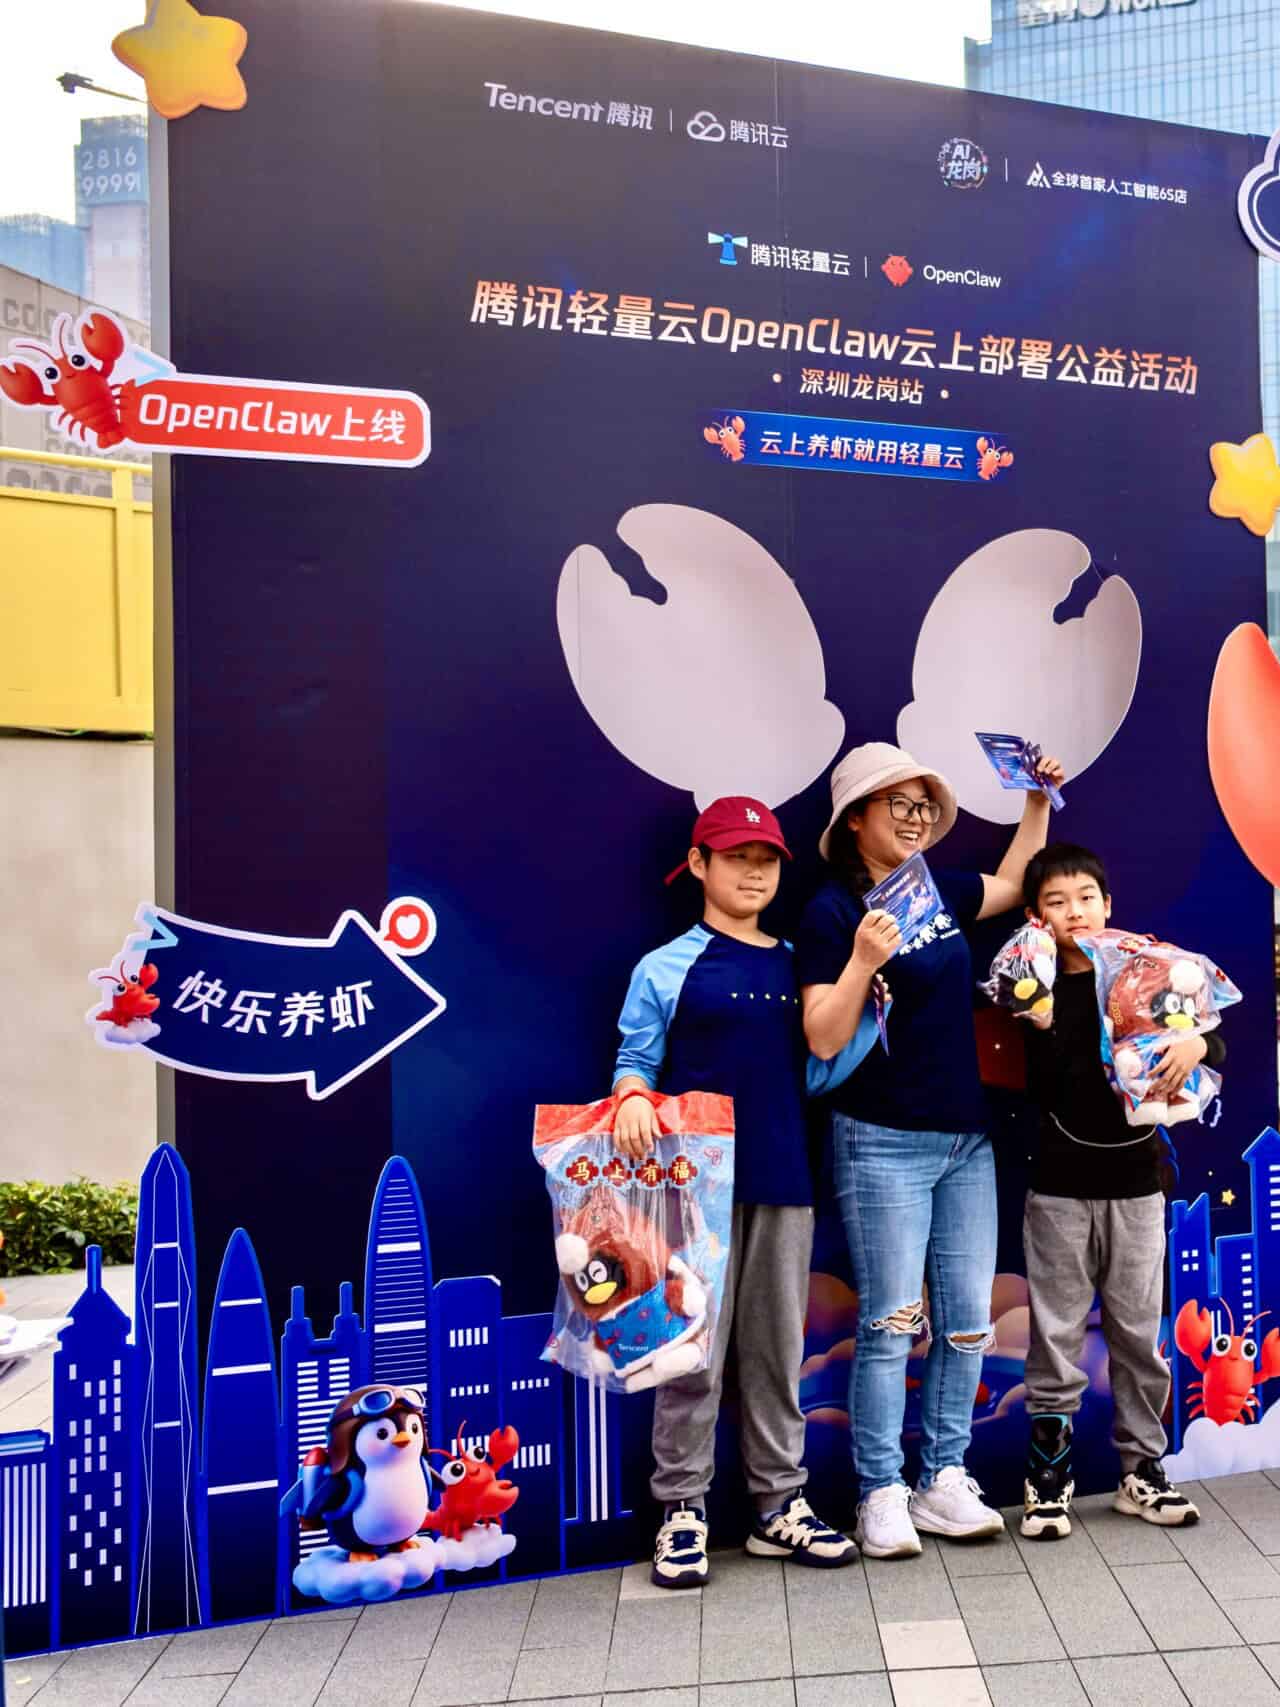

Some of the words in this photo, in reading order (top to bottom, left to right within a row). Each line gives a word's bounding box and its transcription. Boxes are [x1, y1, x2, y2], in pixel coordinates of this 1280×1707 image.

[484, 82, 604, 122] Tencent
[606, 101, 653, 130] 腾讯
[729, 119, 789, 148] 腾讯云
[82, 146, 137, 171] 2816
[952, 144, 970, 160] AI
[946, 157, 981, 181] 龙岗
[751, 244, 850, 276] 腾讯轻量云
[923, 264, 1001, 288] OpenClaw
[470, 280, 1199, 395] 腾讯轻量云OpenClaw云上部署公益活动
[799, 367, 924, 405] 深圳龙岗站
[139, 394, 407, 445] OpenClaw上线
[759, 430, 965, 469] 云上养虾就用轻量云
[745, 808, 760, 823] LA
[172, 971, 375, 1037] 快乐养虾
[573, 1160, 690, 1181] 马上有福
